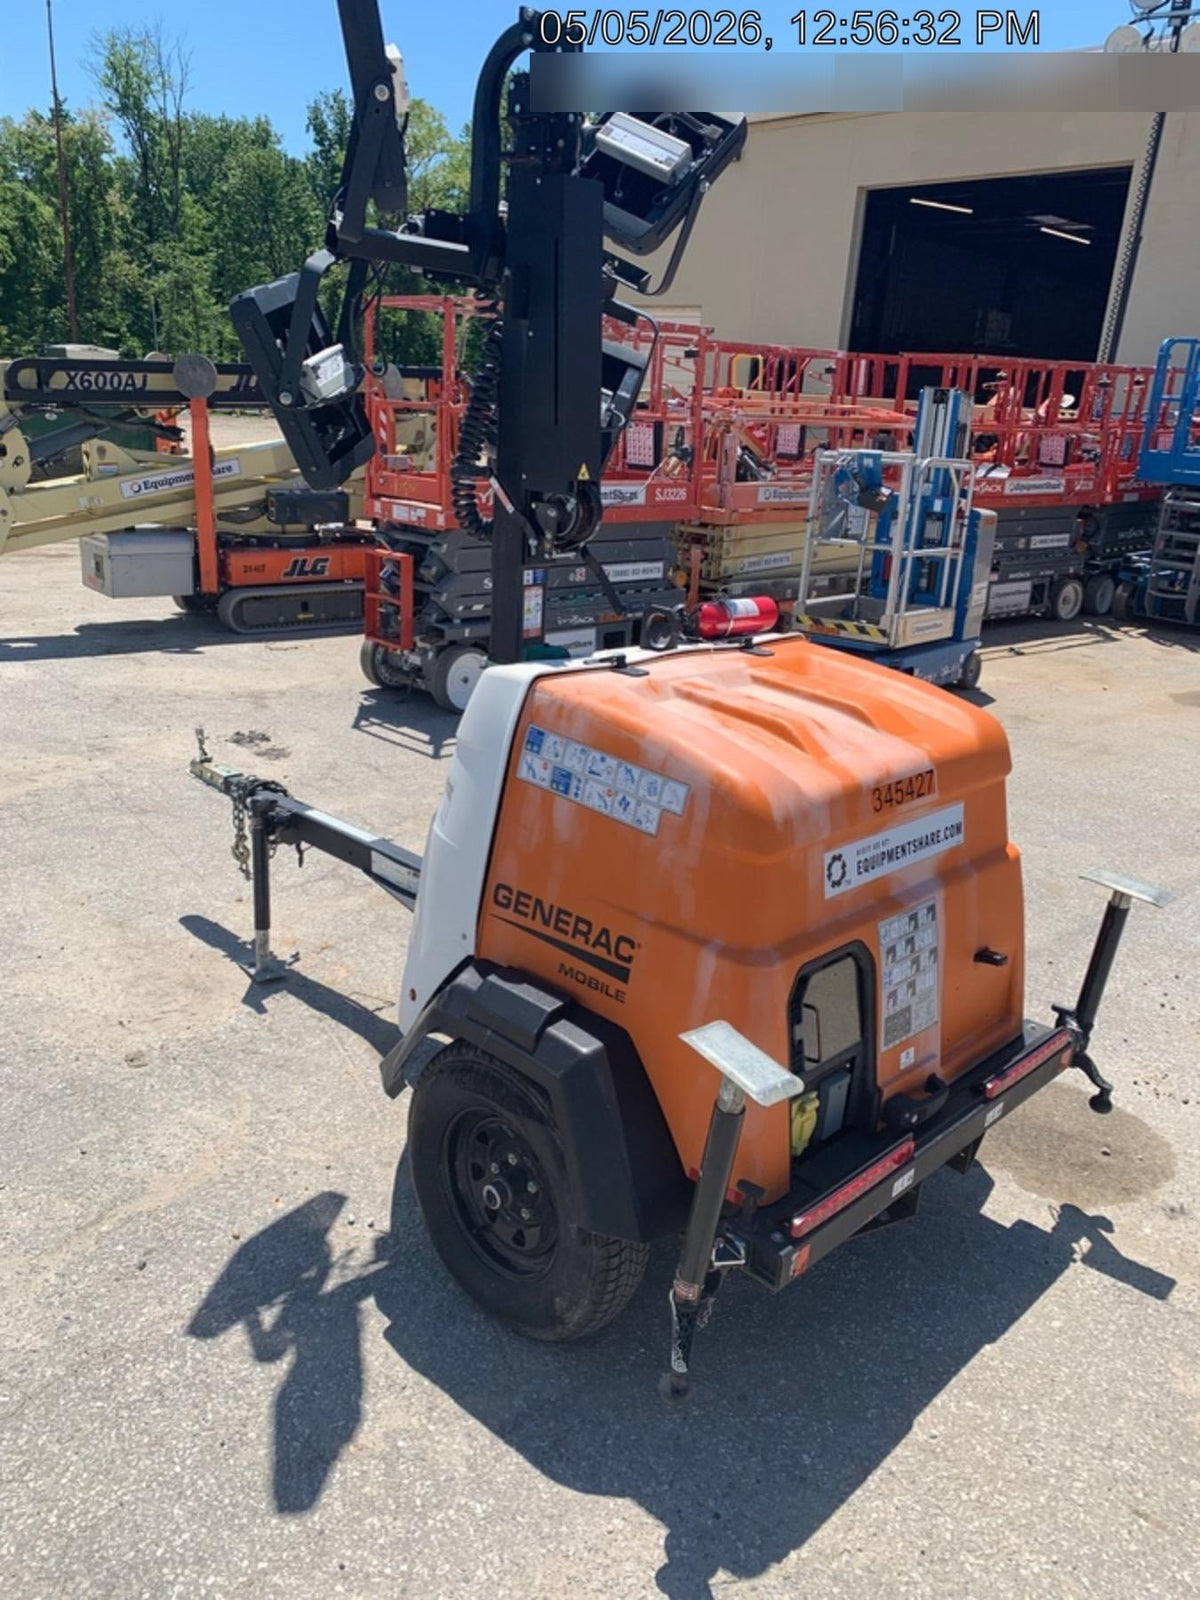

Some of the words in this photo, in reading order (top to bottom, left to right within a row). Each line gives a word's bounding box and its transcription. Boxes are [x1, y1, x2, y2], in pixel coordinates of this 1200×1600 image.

[64, 371, 148, 391] X600AJ
[283, 556, 331, 578] JLG
[872, 768, 934, 813] 345427
[856, 821, 963, 876] EQUIPMENTSHARE.COM
[493, 882, 636, 965] GENERAC
[558, 962, 627, 1004] MOBILE
